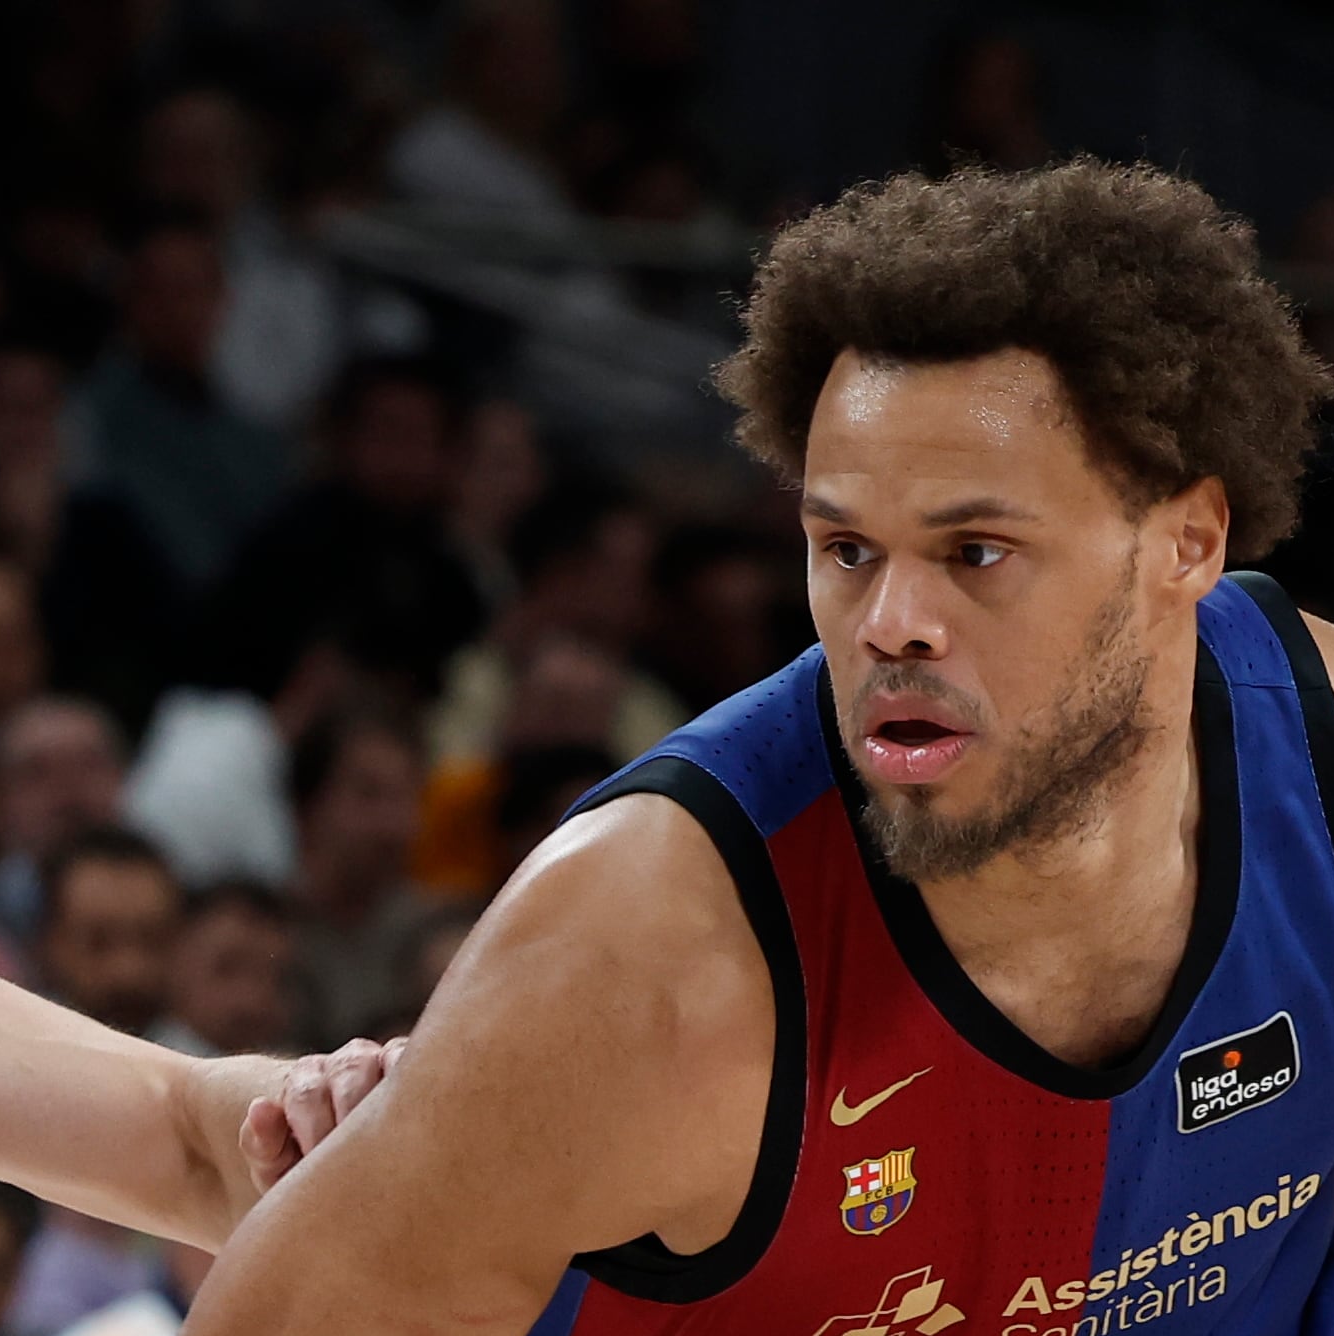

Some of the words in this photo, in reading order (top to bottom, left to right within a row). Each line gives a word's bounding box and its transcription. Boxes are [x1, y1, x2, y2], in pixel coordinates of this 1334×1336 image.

[1191, 1069, 1237, 1100] liga
[1192, 1067, 1291, 1119] endesa
[1002, 1173, 1320, 1317] Assistència
